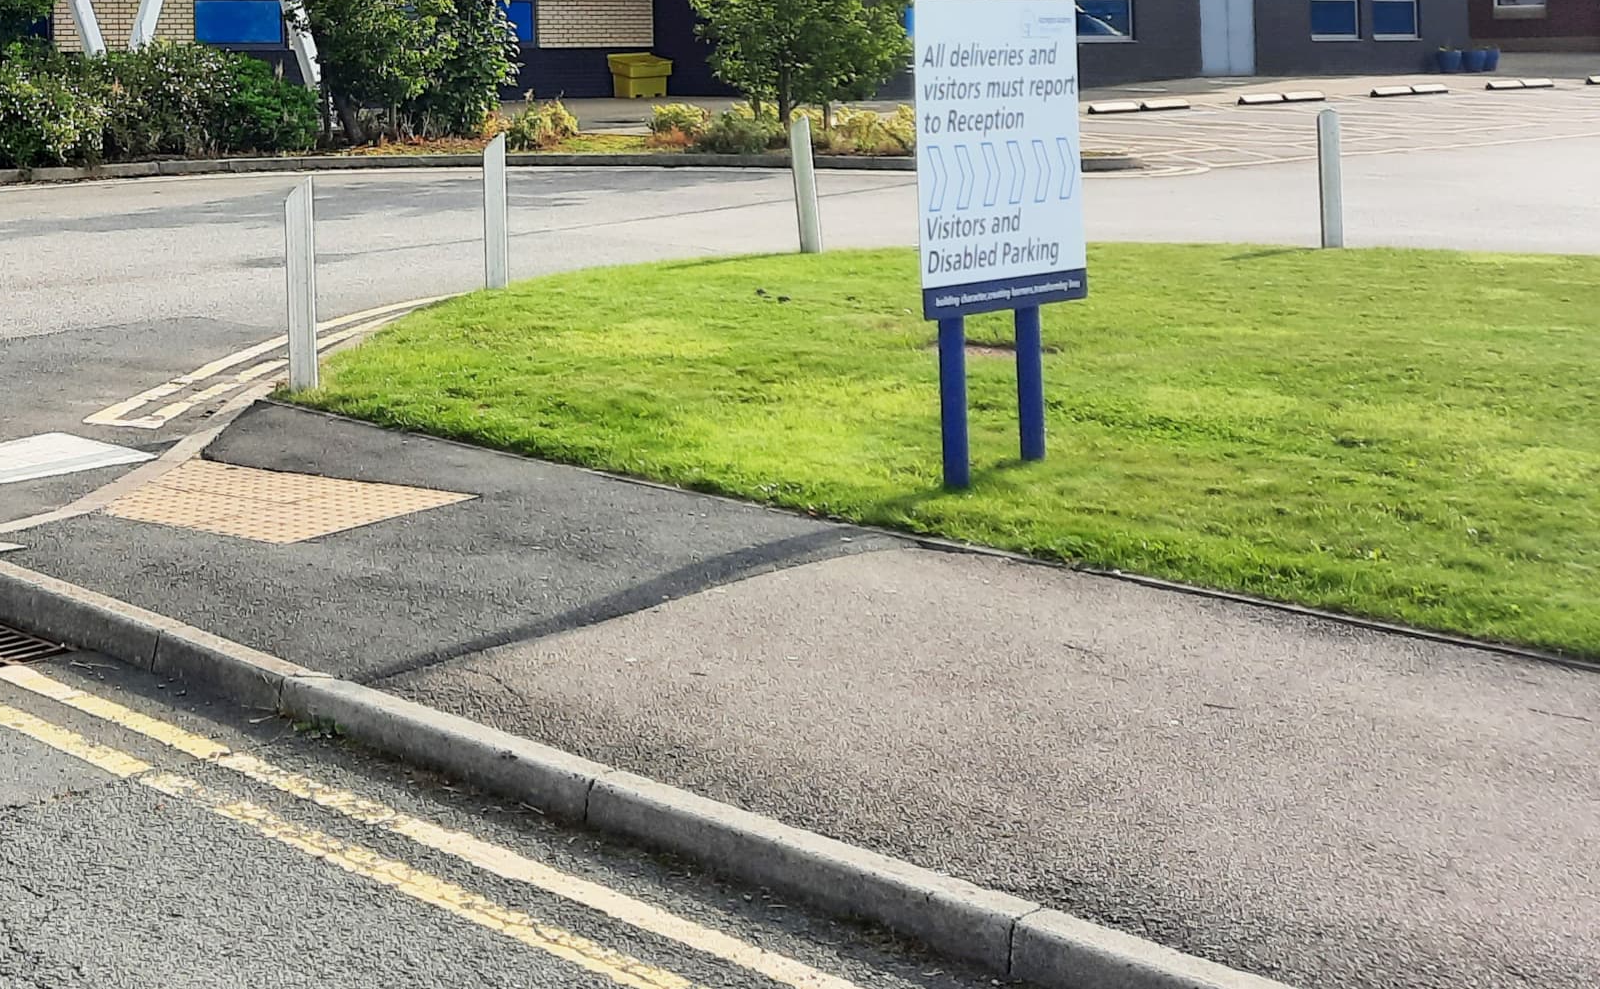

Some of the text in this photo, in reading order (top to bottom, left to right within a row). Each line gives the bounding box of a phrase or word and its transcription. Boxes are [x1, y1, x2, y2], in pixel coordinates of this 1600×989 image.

[922, 41, 1058, 68] All deliveries and
[923, 75, 1075, 102] visitors must report
[924, 106, 1025, 137] to Reception
[926, 207, 1022, 241] Visitors and
[927, 237, 1060, 274] Disabled Parking
